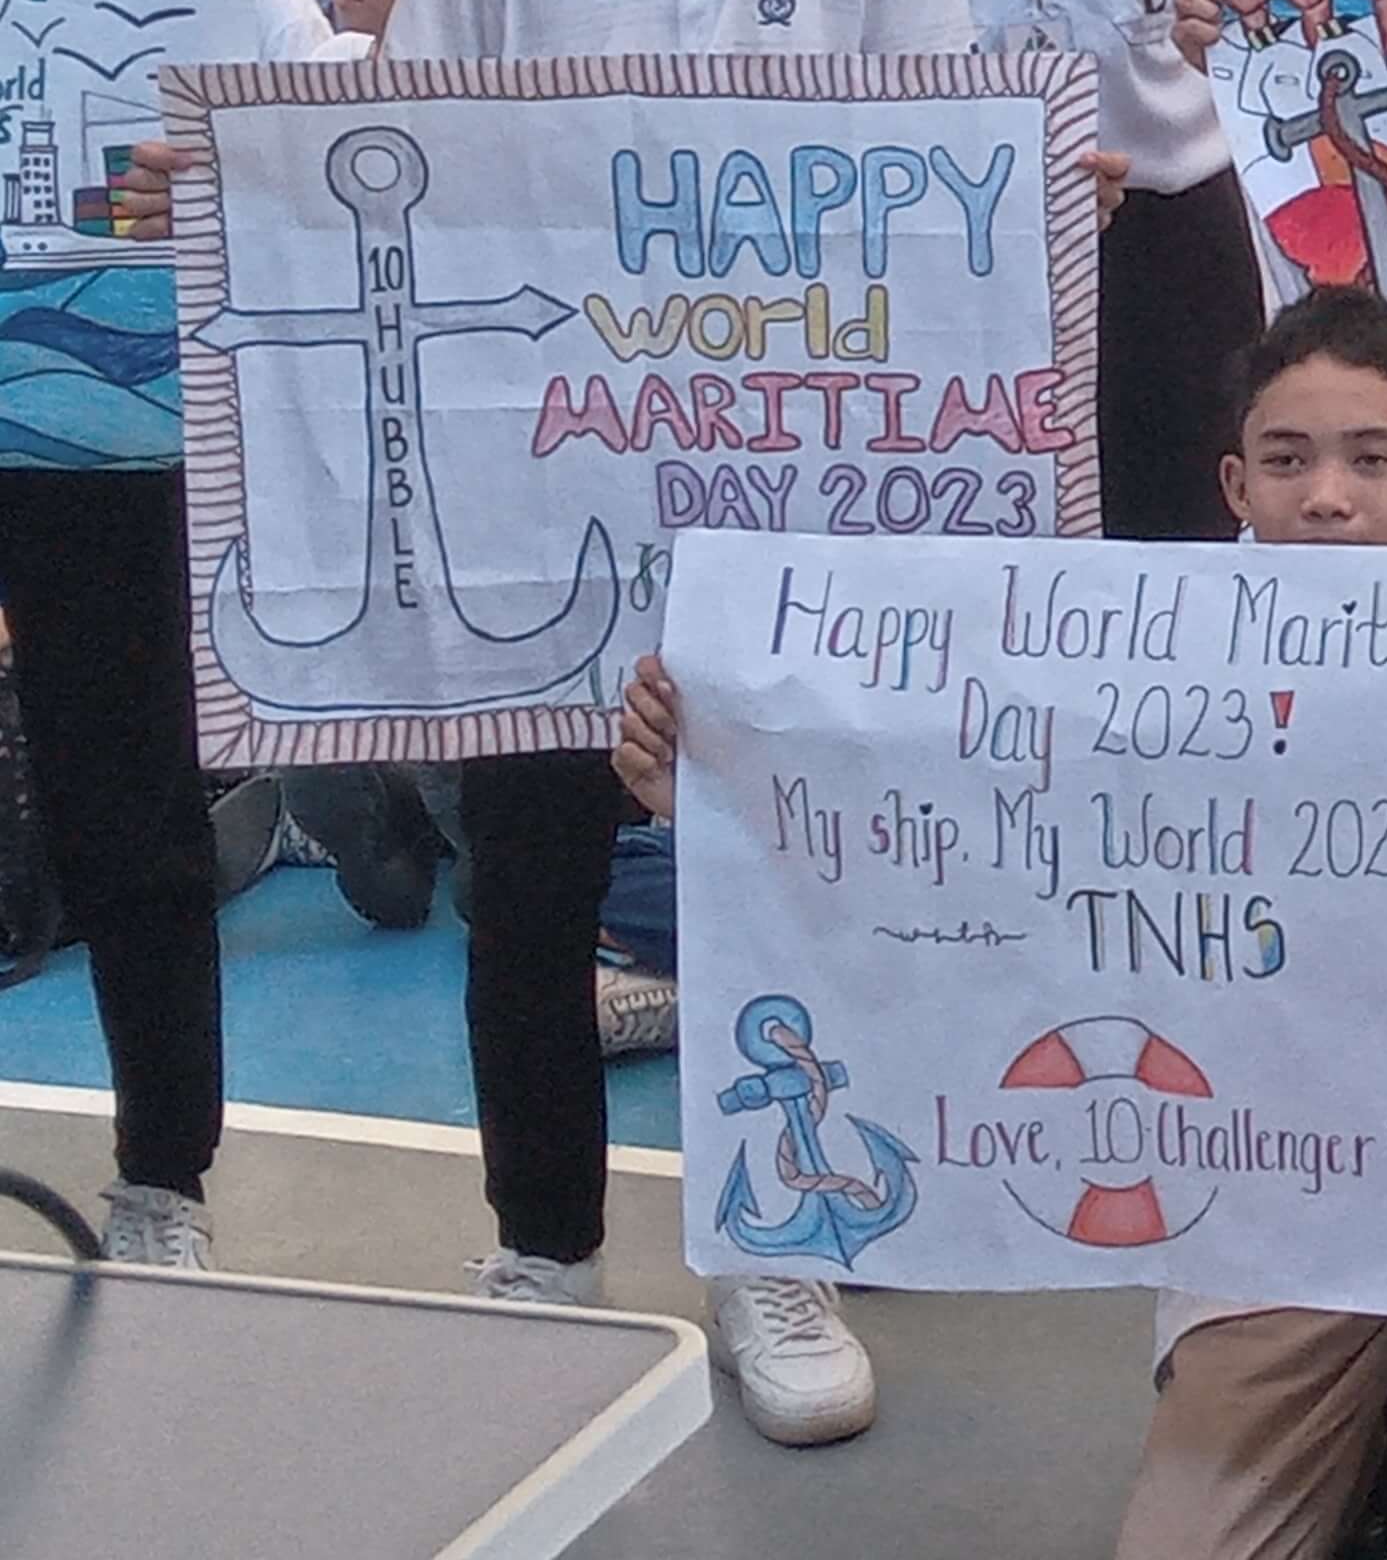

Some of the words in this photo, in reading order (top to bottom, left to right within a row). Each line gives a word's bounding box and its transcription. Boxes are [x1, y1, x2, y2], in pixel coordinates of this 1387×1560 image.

[611, 143, 1015, 278] HAPPY
[367, 245, 404, 294] 10
[582, 281, 889, 363] world
[531, 368, 1076, 458] MARITIME
[655, 460, 798, 530] DAY
[818, 464, 1038, 536] 2023
[768, 565, 954, 692] Happy
[999, 563, 1190, 663] World
[957, 676, 1058, 793] Day
[1093, 682, 1297, 762] 2023!
[772, 775, 842, 884] My
[992, 786, 1061, 899] My
[1090, 790, 1257, 877] World
[1065, 889, 1289, 982] TNHS
